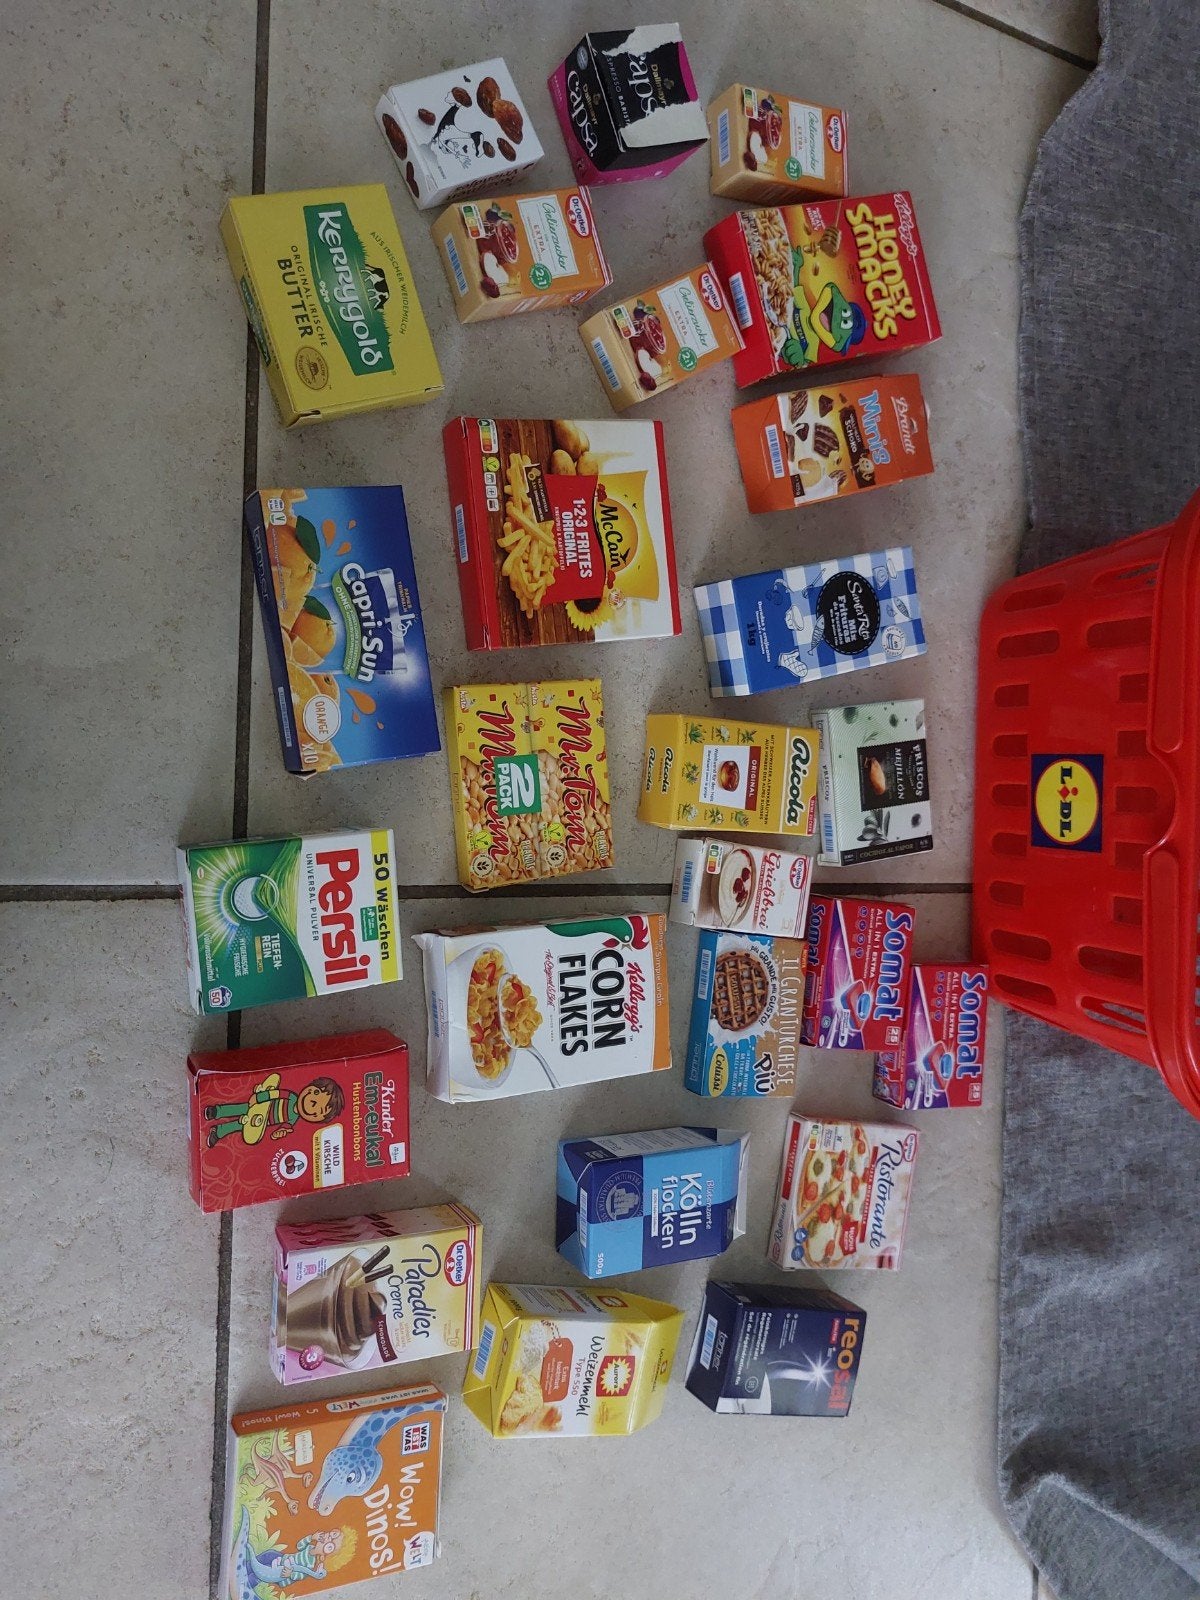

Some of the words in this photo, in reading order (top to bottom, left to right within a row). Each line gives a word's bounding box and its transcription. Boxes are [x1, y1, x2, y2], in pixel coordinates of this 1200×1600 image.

[651, 64, 667, 105] Dallmayr
[534, 225, 545, 253] EXTRA
[542, 203, 567, 271] Gelierzucker
[893, 194, 917, 256] Kellogg's
[369, 232, 384, 246] AUS
[383, 247, 404, 282] IRISCHER
[399, 284, 410, 335] WEIDEMILCH
[536, 269, 546, 285] 2:1
[845, 203, 898, 341] SMACKS
[871, 214, 916, 319] HONEY
[277, 258, 314, 338] BUTTER
[290, 245, 311, 299] ORIGINAL
[309, 303, 328, 348] IRISCHE
[679, 287, 709, 348] Gelierzucker
[675, 311, 688, 336] EXTRA
[682, 352, 694, 368] 2:1
[844, 420, 857, 453] SCHOKO
[857, 390, 891, 465] Minis
[895, 397, 915, 455] Brandt
[562, 512, 578, 566] ORIGINAL
[576, 532, 592, 578] FRITES
[600, 503, 622, 569] McCain
[335, 586, 350, 610] OHNE
[838, 595, 851, 643] Frituras
[847, 580, 864, 615] Santa
[857, 614, 870, 640] Rita
[341, 562, 383, 682] Capri-Sun
[835, 612, 843, 644] Pescados
[849, 619, 857, 641] Mix
[315, 701, 328, 735] ORANGE
[497, 763, 513, 809] PACK
[510, 763, 535, 808] 2
[646, 747, 656, 792] Ricola
[661, 747, 673, 794] Ricola
[749, 760, 757, 797] ORIGINAL
[787, 737, 810, 826] Ricola
[894, 747, 905, 800] MEJILLÓN
[764, 779, 772, 825] ALPENKRÄUTERN
[305, 853, 317, 904] UNIVERSAL
[373, 852, 390, 882] 50
[759, 852, 781, 930] Grießbrei
[310, 907, 319, 942] PULVER
[316, 848, 371, 986] Persil
[376, 887, 391, 961] Wäschen
[808, 904, 824, 966] Somat
[874, 931, 880, 942] IN
[875, 908, 883, 927] ALL
[233, 952, 241, 977] FRISCHE
[240, 938, 249, 976] HYGIENISCHE
[261, 935, 272, 958] REIN
[271, 933, 283, 970] TIEFEN-
[655, 951, 663, 981] Simple
[759, 952, 777, 982] GRANDE
[781, 958, 799, 973] IL
[869, 951, 877, 978] EXTRA
[873, 910, 912, 1021] Somat
[211, 990, 220, 1004] 50
[558, 954, 589, 1057] FLAKES
[591, 949, 627, 1051] CORN
[624, 962, 646, 1033] Kellogg's
[656, 982, 664, 1007] Grain
[759, 995, 776, 1026] GUSTO!
[951, 993, 958, 1004] IN
[891, 1028, 898, 1043] 25
[956, 972, 987, 1079] Somat
[712, 1053, 725, 1091] Colussi
[973, 1085, 980, 1099] 25
[352, 1082, 362, 1161] Hustenbonbons
[381, 1079, 395, 1137] Kinder
[270, 1148, 285, 1187] ZUCKERFREI
[324, 1139, 332, 1175] KIRSCHE
[332, 1145, 340, 1167] WILD
[661, 1176, 678, 1249] flocken
[679, 1172, 703, 1245] Kölln
[705, 1179, 714, 1229] Blütenzarte
[869, 1140, 903, 1249] Ristorante
[388, 1275, 404, 1320] Creme
[401, 1244, 442, 1338] Paradies
[377, 1320, 391, 1358] SCHOKOLADE
[574, 1357, 585, 1378] Type
[575, 1336, 605, 1417] Weizenmehl
[827, 1318, 860, 1409] reosal
[329, 1401, 360, 1410] WELT
[571, 1380, 580, 1396] 550
[241, 1417, 273, 1428] Dinos!
[275, 1411, 300, 1422] Wow!
[412, 1428, 420, 1448] IST
[419, 1425, 428, 1448] WAS
[404, 1428, 412, 1451] WAS
[395, 1461, 424, 1528] Wow!
[363, 1484, 401, 1576] Dinos!
[408, 1537, 422, 1566] WELT
